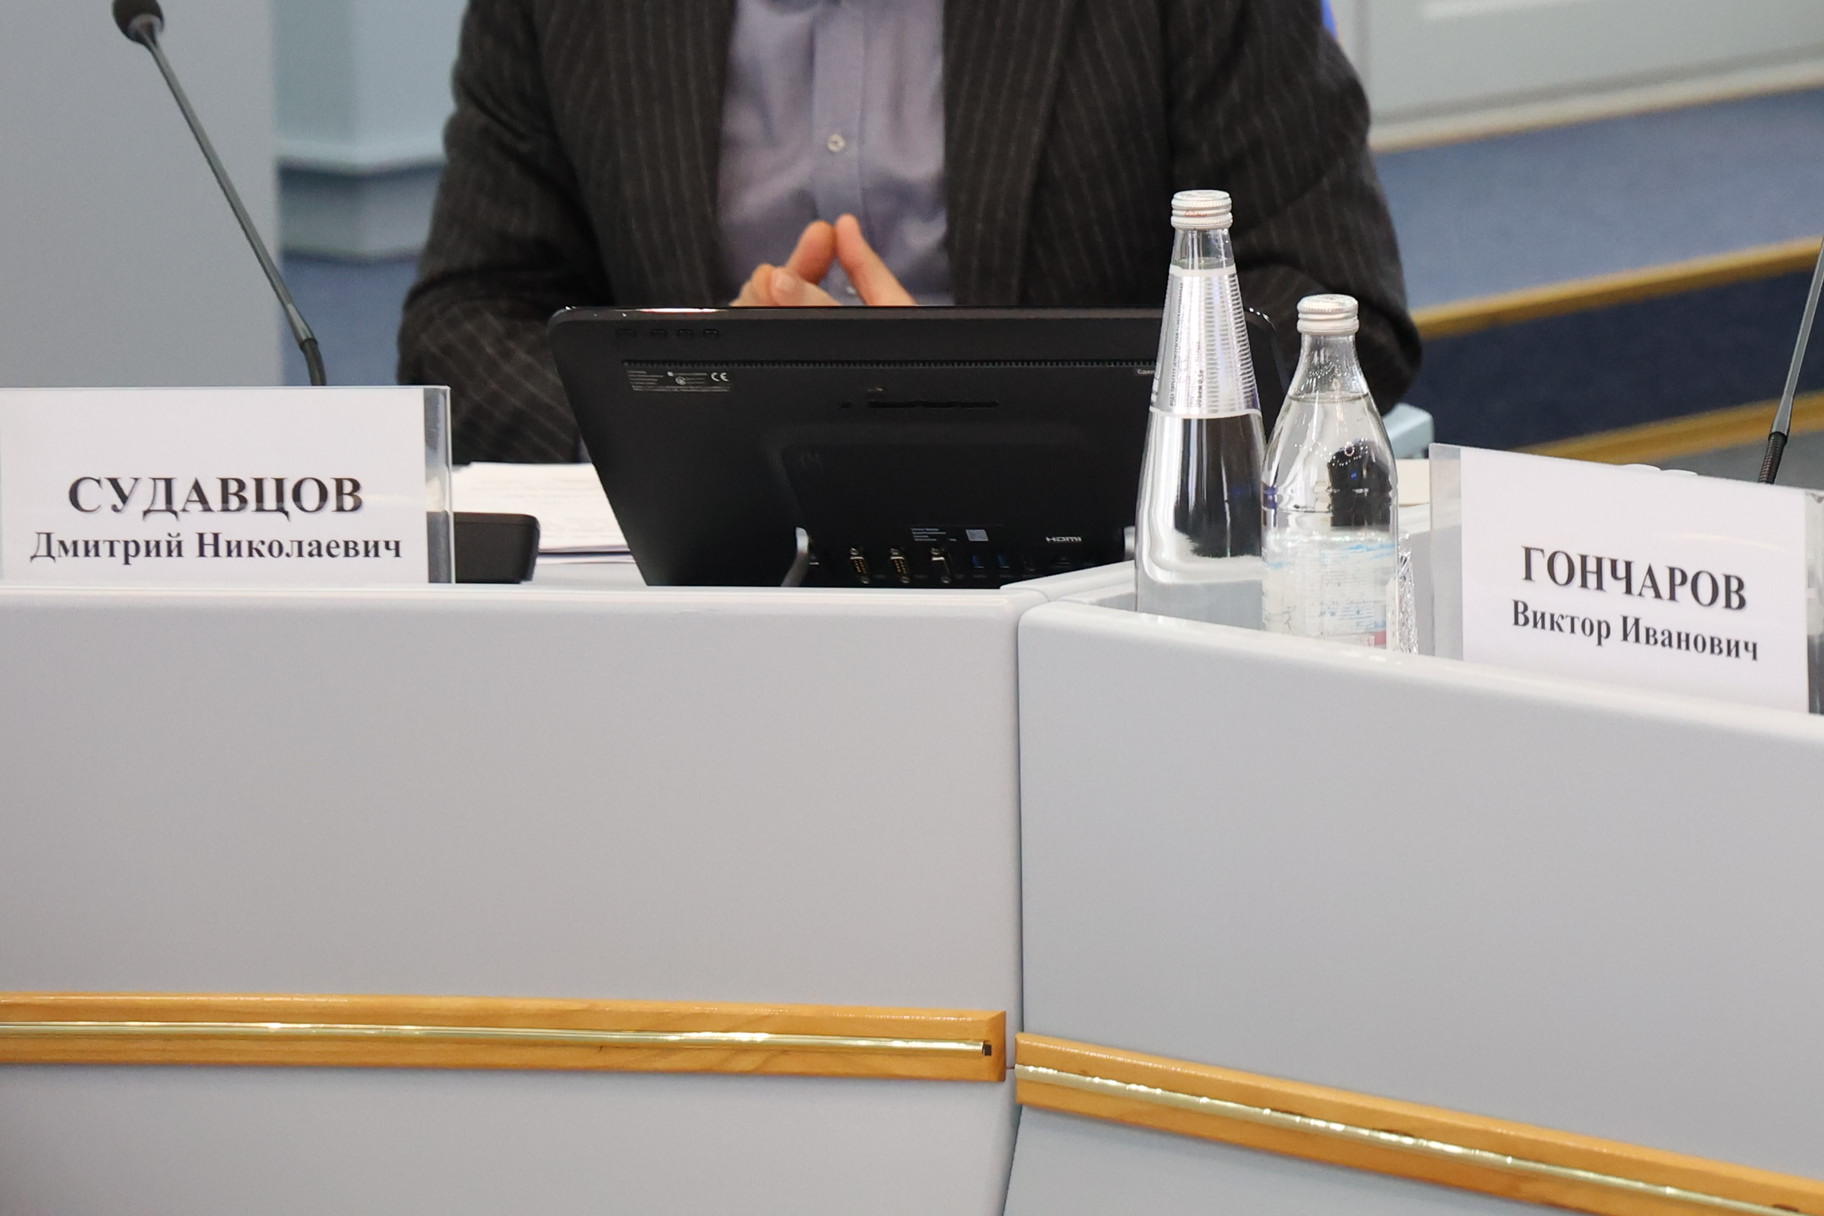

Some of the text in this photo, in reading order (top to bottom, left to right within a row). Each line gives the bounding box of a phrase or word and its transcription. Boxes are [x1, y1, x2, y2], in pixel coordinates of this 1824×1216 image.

[68, 476, 364, 521] СУДАВЦОВ
[29, 531, 402, 566] Дмитрий Николаевич
[1521, 545, 1747, 611] ГОНЧАРОВ
[1512, 599, 1758, 662] Виктор Иванович
